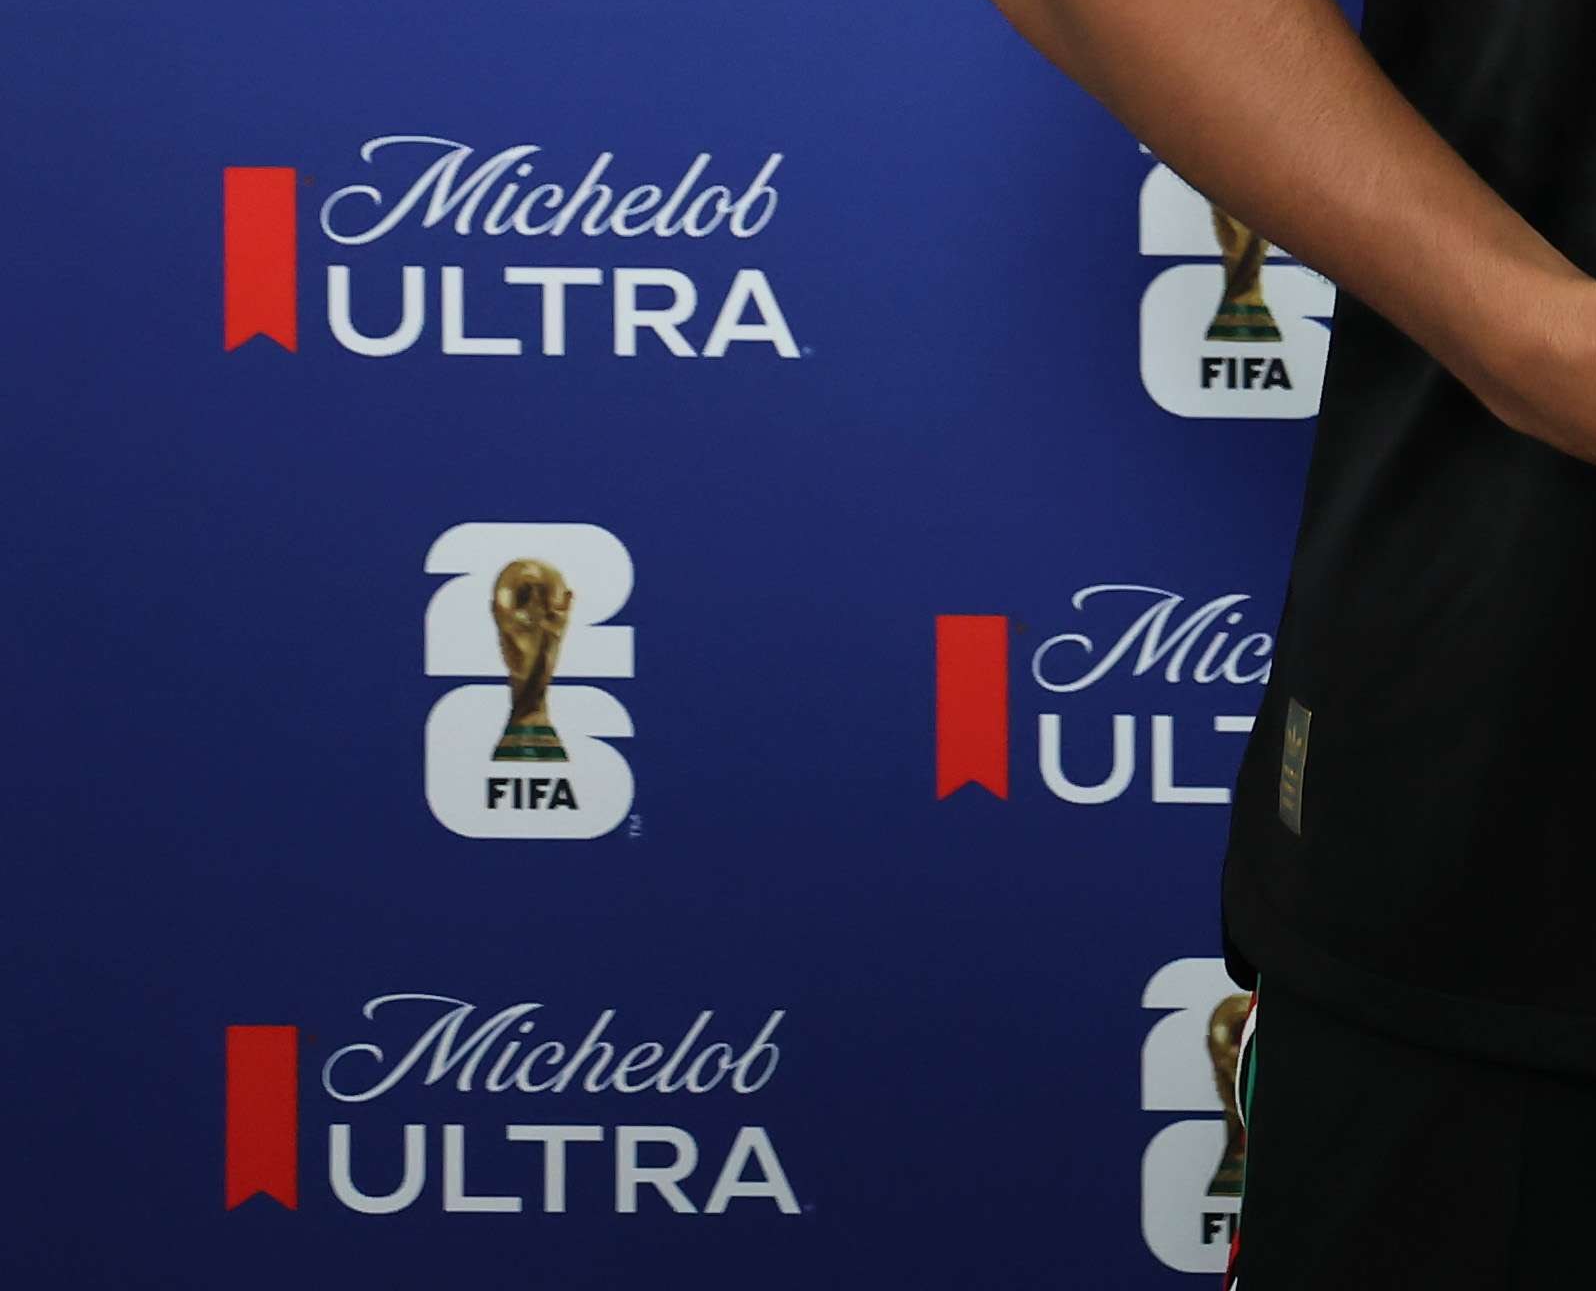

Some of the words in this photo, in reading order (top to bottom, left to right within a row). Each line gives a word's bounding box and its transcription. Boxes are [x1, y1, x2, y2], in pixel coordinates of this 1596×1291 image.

[320, 136, 782, 245] Michelob
[327, 265, 800, 358] ULTRA
[1202, 357, 1292, 390] FIFA
[488, 778, 578, 809] FIFA
[323, 994, 785, 1102] Michelob
[329, 1124, 801, 1214] ULTRA
